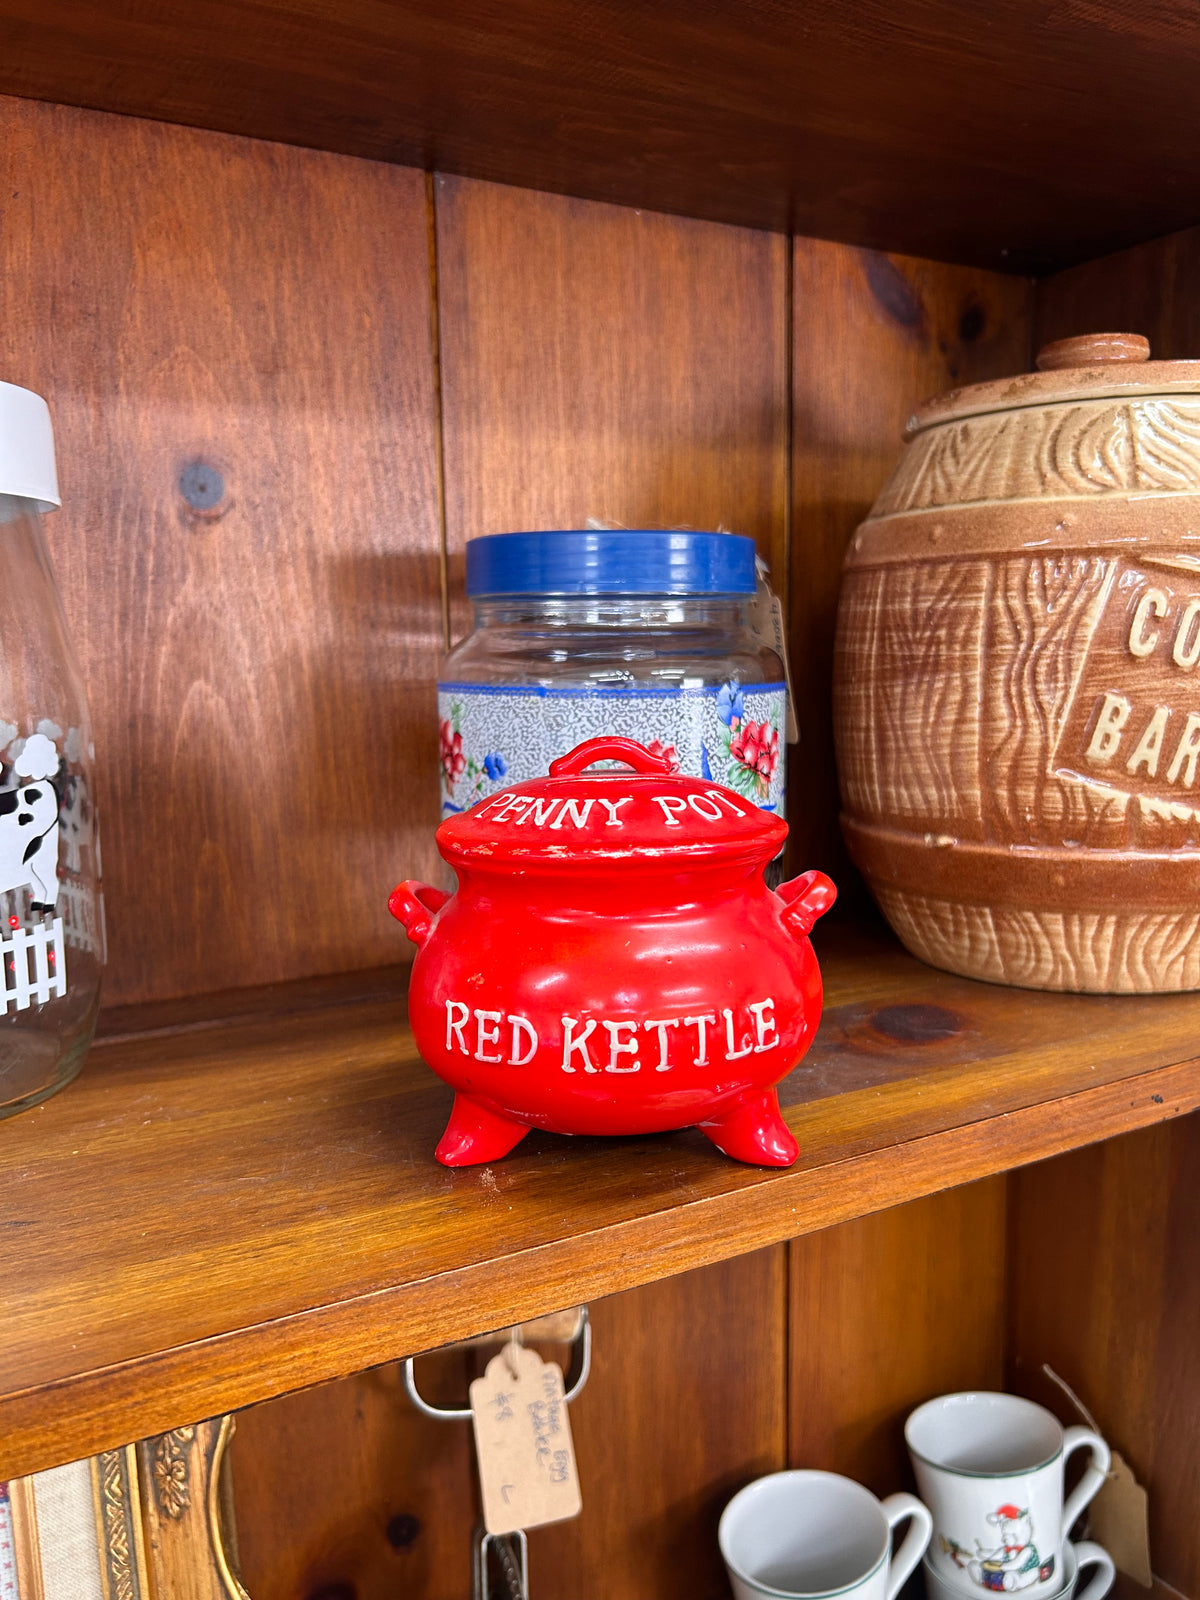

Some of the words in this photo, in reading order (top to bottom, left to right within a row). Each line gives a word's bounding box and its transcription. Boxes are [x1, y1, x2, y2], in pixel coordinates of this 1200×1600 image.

[474, 792, 634, 829] PENNY
[651, 790, 747, 826] POT
[445, 999, 539, 1066] RED
[560, 997, 780, 1074] KETTLE
